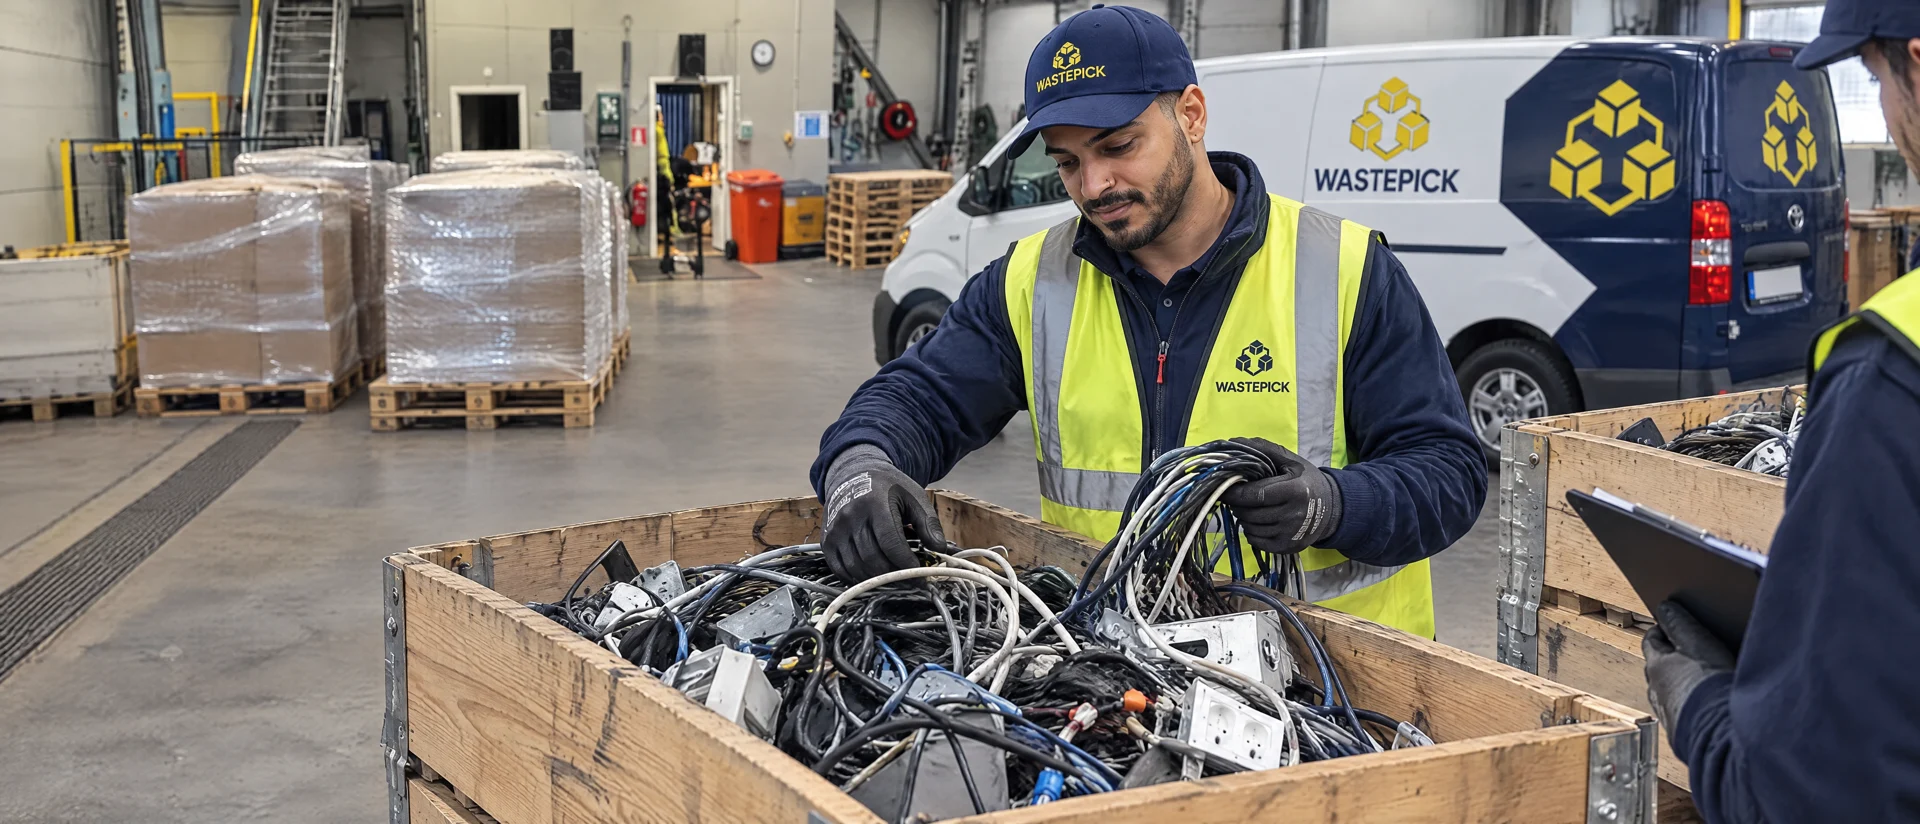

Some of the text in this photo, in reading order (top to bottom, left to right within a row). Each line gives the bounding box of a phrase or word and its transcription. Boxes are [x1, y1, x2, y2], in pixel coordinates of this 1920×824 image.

[1036, 65, 1106, 93] WASTEPICK
[1314, 168, 1459, 193] WASTEPICK
[1215, 381, 1290, 393] WASTEPICK
